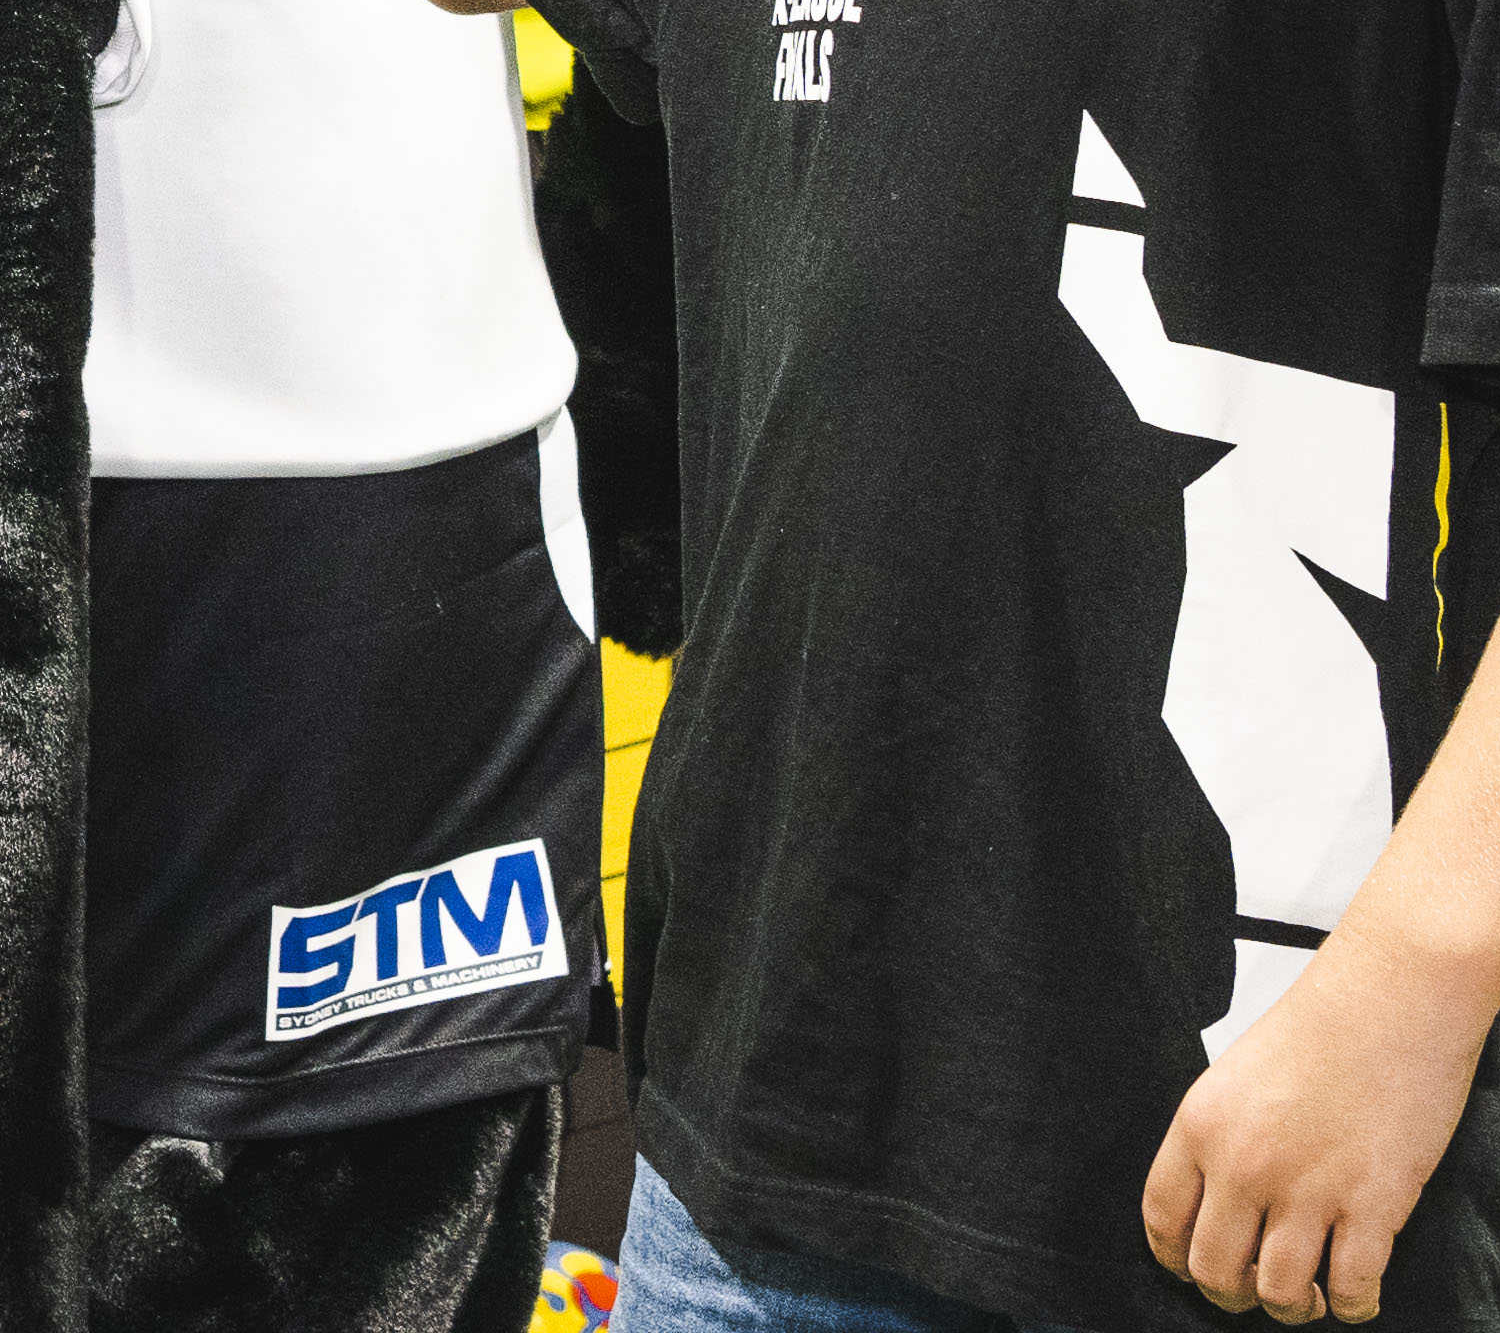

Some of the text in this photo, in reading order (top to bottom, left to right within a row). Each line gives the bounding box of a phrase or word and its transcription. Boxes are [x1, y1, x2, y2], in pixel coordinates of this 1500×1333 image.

[276, 849, 550, 1010] STM
[277, 955, 541, 1030] SYDNEY TRUCKS & MACHINERY
